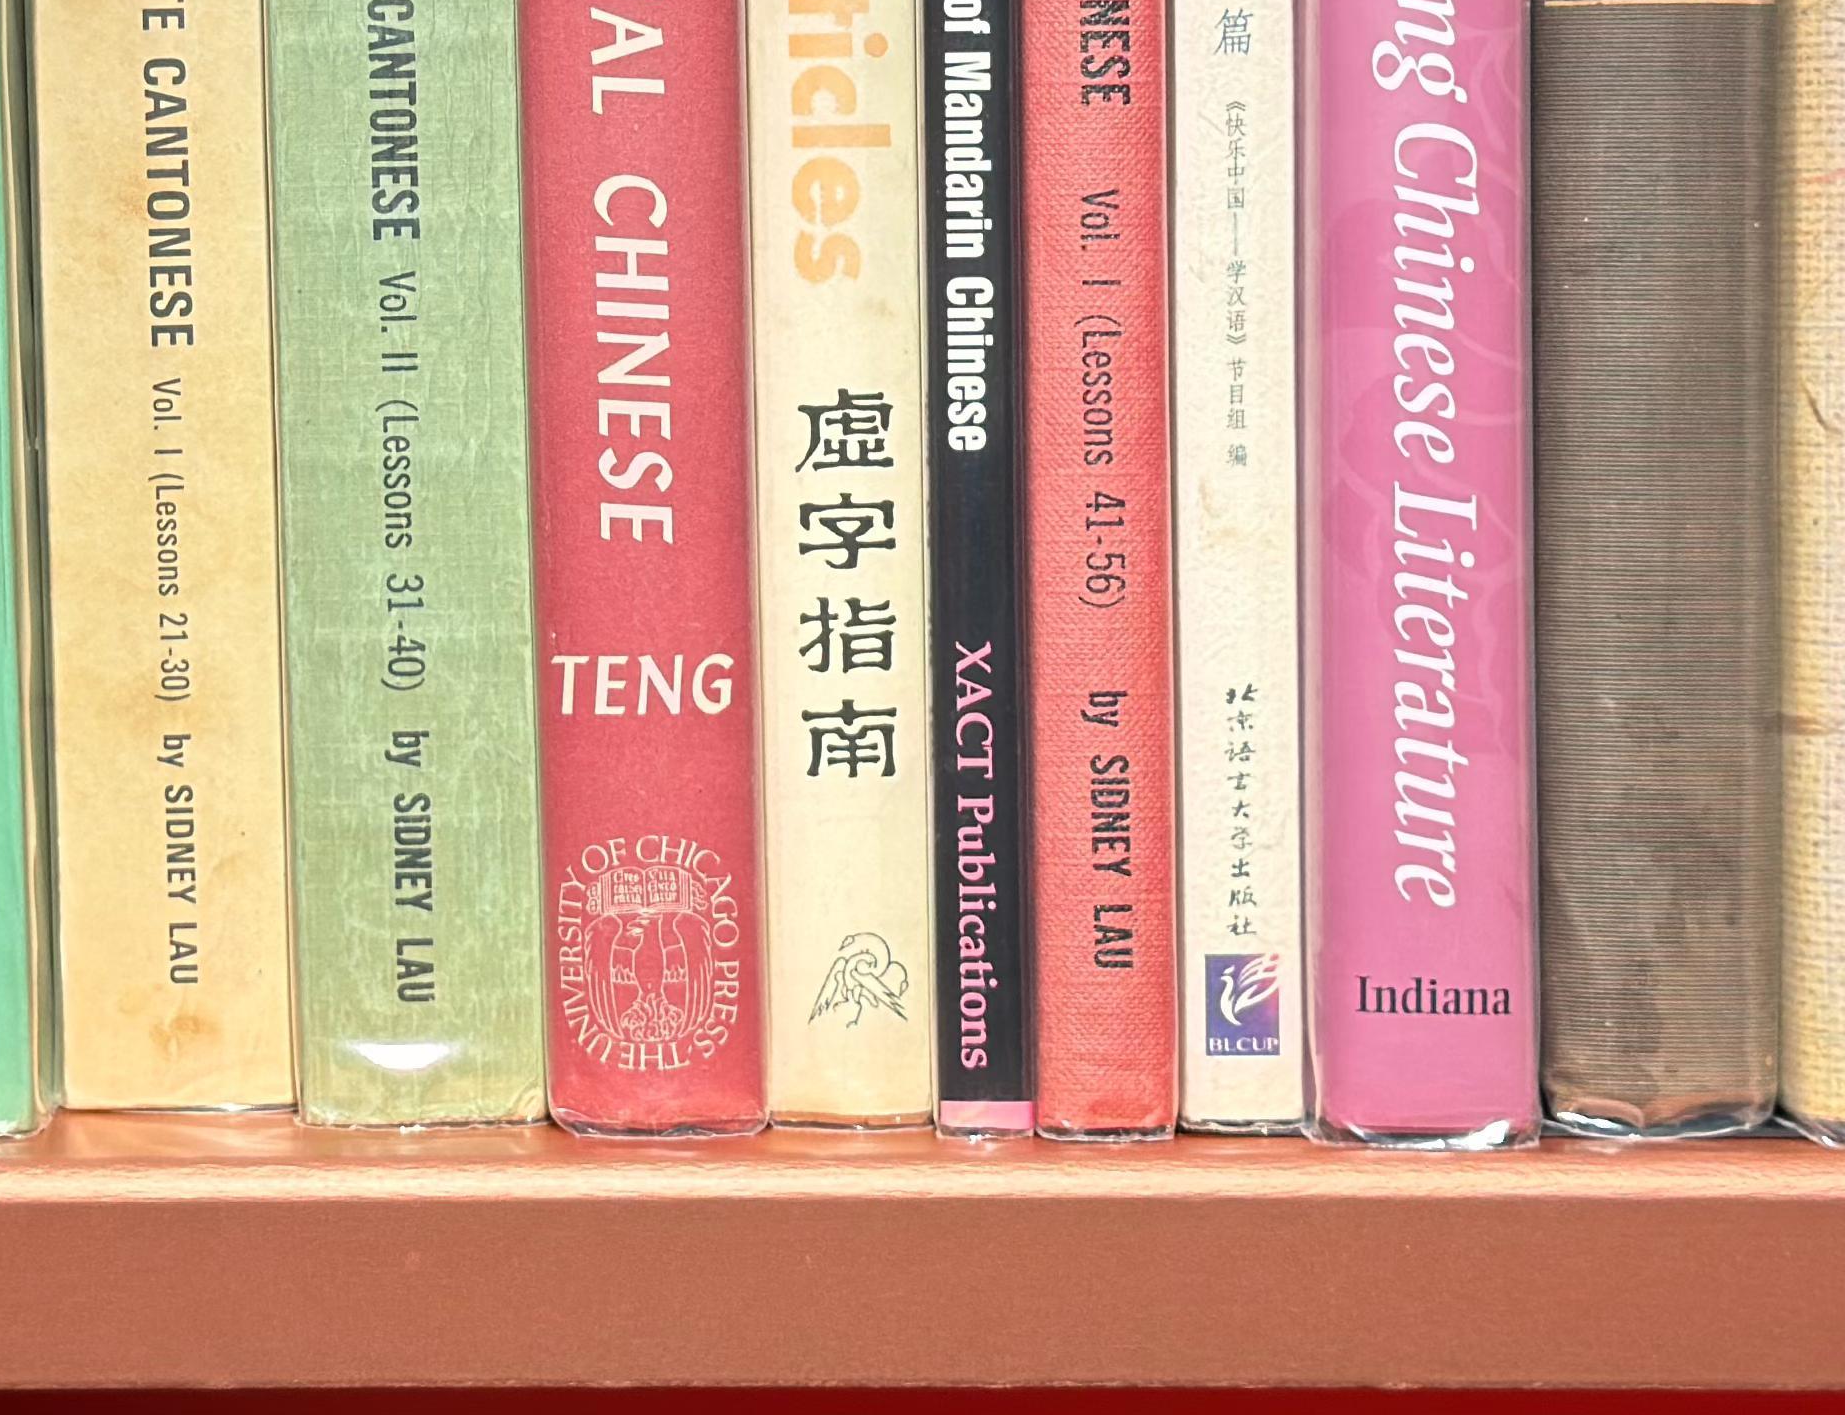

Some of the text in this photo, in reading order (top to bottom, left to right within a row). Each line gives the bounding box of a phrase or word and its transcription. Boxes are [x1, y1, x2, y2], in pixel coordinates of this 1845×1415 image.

[141, 56, 195, 349] CANTONESE
[944, 51, 994, 259] Mandarin
[1080, 188, 1121, 252] Vol.
[377, 269, 419, 334] Vol.
[1081, 279, 1123, 287] I
[1392, 120, 1481, 465] Chinese
[151, 377, 183, 432] Vol.
[380, 350, 420, 374] II
[592, 173, 675, 545] CHINESE
[945, 276, 996, 453] Chinese
[1074, 313, 1124, 467] (Lessons
[152, 447, 184, 456] I
[373, 398, 421, 551] (Lessons
[147, 470, 182, 597] (Lessons
[1078, 490, 1127, 610] 41-56)
[154, 611, 192, 703] 21-30)
[380, 572, 426, 692] 31-40)
[550, 652, 735, 716] TENG
[1080, 689, 1129, 729] by
[1392, 479, 1479, 909] Literature
[156, 733, 193, 771] by
[383, 729, 431, 770] by
[162, 783, 200, 905] SIDNEY
[392, 790, 436, 912] SIDNEY
[580, 836, 628, 874] OF
[954, 640, 999, 1070] XACT Publications
[1088, 753, 1134, 878] SIDNEY
[635, 834, 740, 948] CHICAGO
[1092, 902, 1135, 971] LAU
[167, 921, 200, 986] LAU
[395, 936, 437, 1004] LAU
[557, 863, 613, 1064] UNIVERSITY
[1354, 975, 1512, 1016] Indiana
[617, 1040, 691, 1072] THE
[692, 960, 741, 1060] PRESS
[1208, 1037, 1281, 1053] BLCUP
